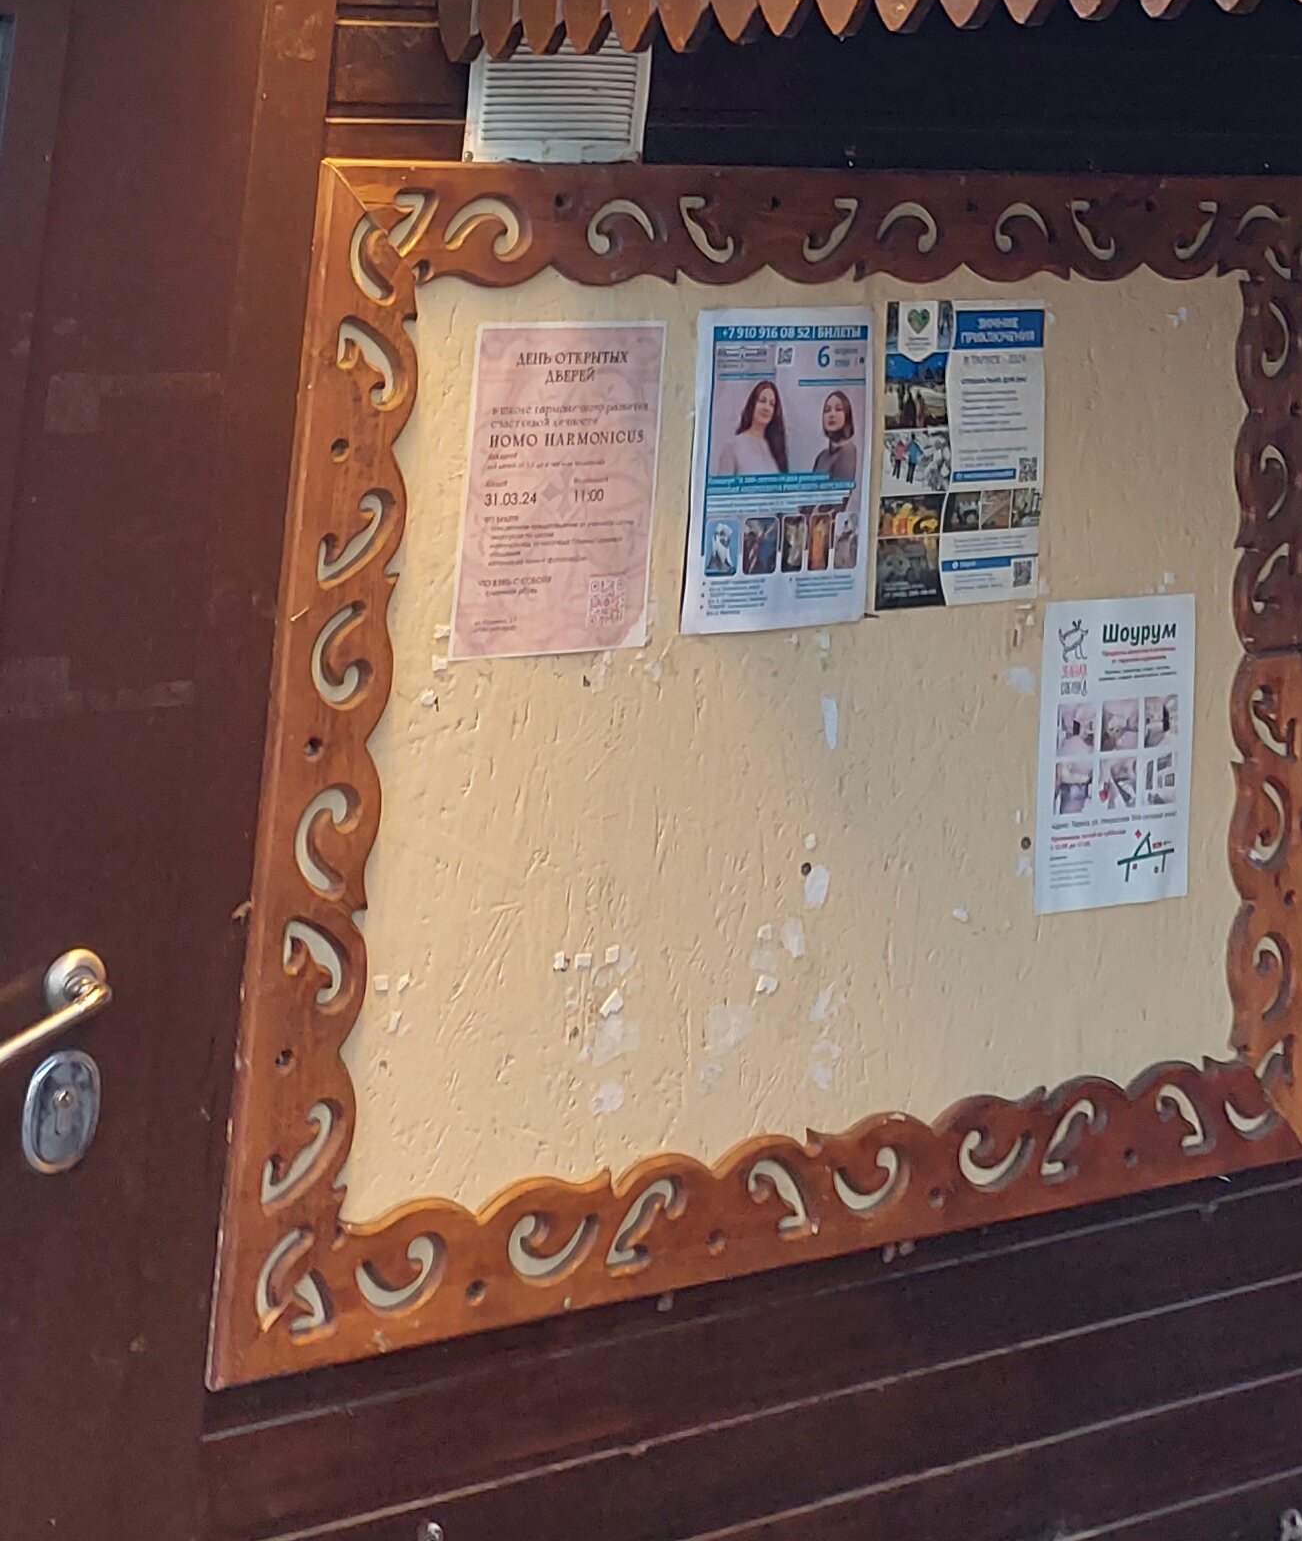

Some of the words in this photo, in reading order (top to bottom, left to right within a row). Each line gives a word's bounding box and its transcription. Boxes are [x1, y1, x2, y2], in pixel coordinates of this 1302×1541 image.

[736, 327, 756, 339] 910
[758, 327, 778, 339] 916
[779, 327, 795, 338] 08
[817, 326, 861, 338] БИЛЕТЫ
[516, 351, 551, 367] ДЕНЬ
[554, 350, 629, 365] ОТКРЫТЫХ
[817, 345, 830, 368] 6
[544, 366, 596, 384] ДВЕРЕЙ
[489, 432, 538, 448] HOMO
[544, 429, 644, 447] HARMONICUS
[484, 492, 537, 506] 31.03.24
[574, 488, 604, 502] 11:00
[1102, 622, 1177, 646] Шоурум
